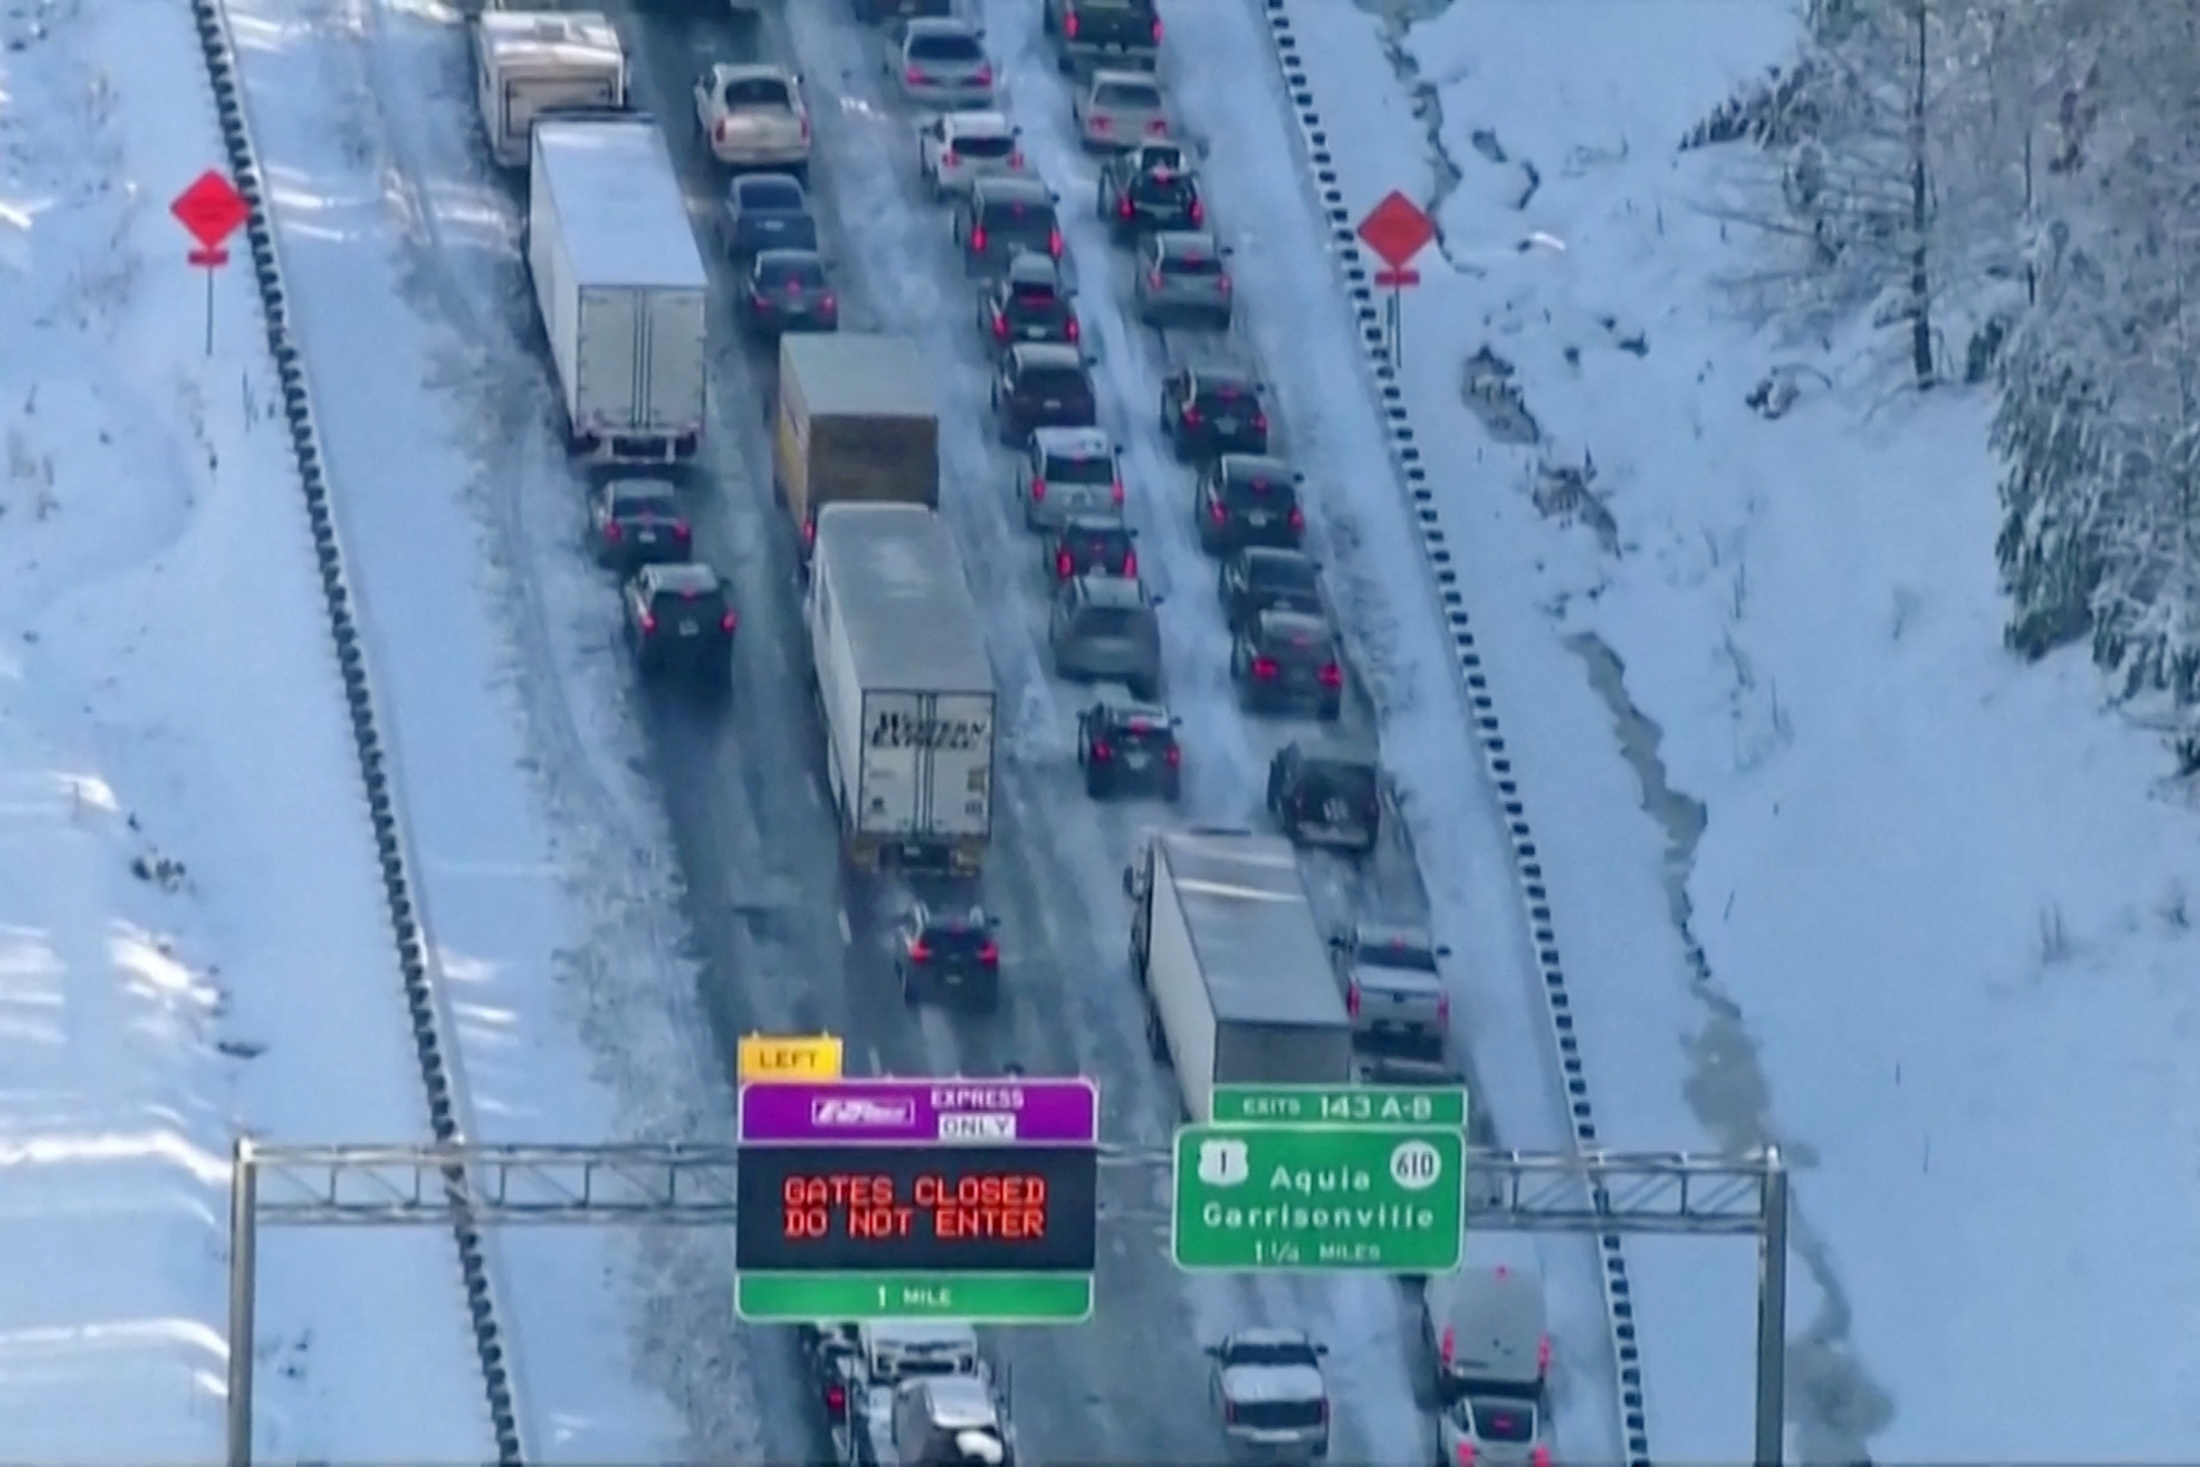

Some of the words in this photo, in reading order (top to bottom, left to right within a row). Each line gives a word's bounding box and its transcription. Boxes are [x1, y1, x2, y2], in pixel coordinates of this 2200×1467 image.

[759, 1049, 819, 1068] LEFT
[931, 1087, 1024, 1109] EXPRESS
[1243, 1098, 1300, 1116] EXITS
[1319, 1096, 1372, 1119] 143
[1380, 1096, 1433, 1120] A-B
[943, 1116, 1010, 1137] ONLY
[1220, 1151, 1227, 1174] 1
[1396, 1153, 1433, 1177] 610
[784, 1176, 894, 1206] GATES
[915, 1176, 1045, 1206] CLOSED
[1270, 1165, 1370, 1197] Aquia
[784, 1208, 828, 1237] DO
[848, 1208, 913, 1237] NOT
[935, 1208, 1044, 1237] ENTER
[1202, 1202, 1434, 1229] Garrisonville
[1319, 1243, 1381, 1263] MILES
[877, 1285, 886, 1309] 1
[902, 1287, 952, 1306] MILE
